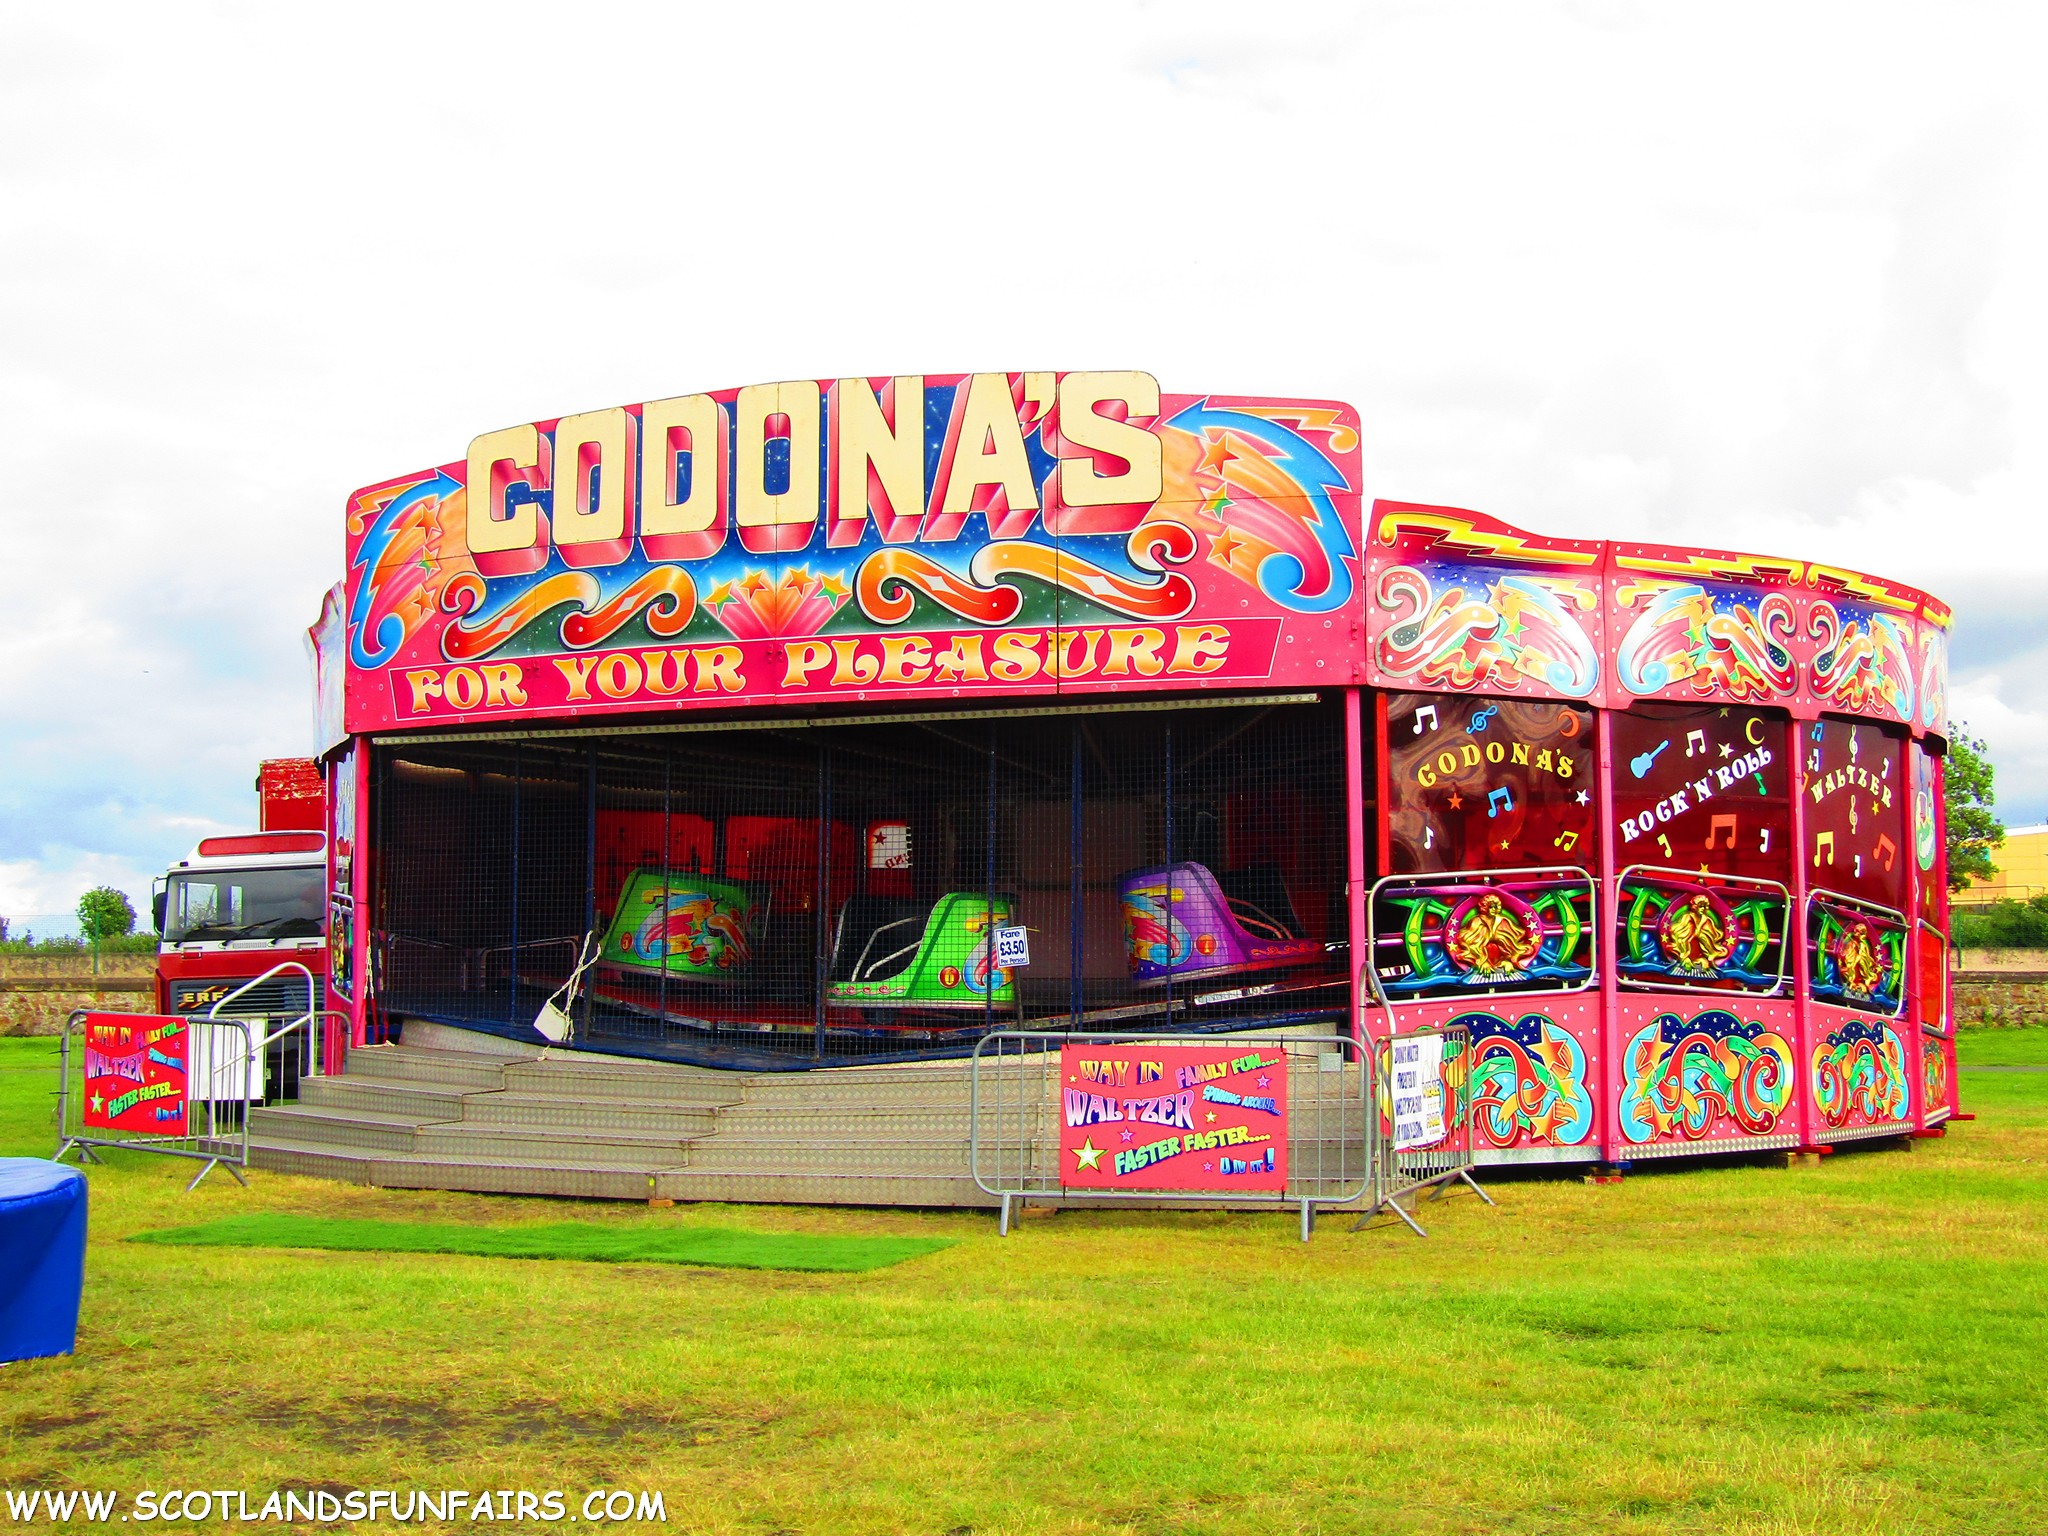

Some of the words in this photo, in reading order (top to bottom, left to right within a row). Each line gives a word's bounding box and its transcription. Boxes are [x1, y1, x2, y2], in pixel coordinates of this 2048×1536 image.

[466, 370, 1163, 558] CODONA'S
[405, 664, 528, 713] FOR
[552, 645, 747, 702] YOUR
[780, 625, 1231, 688] PLEASURE
[1417, 742, 1574, 788] CODONA'S
[1810, 764, 1892, 808] WALTZER
[1000, 930, 1020, 938] Fare
[1000, 939, 1025, 956] £3.50
[182, 991, 224, 1003] ERF
[119, 1027, 131, 1045] IN
[87, 1047, 145, 1084] WALTZER
[1079, 1060, 1130, 1086] WAY
[1138, 1061, 1164, 1084] IN
[1175, 1062, 1228, 1089] FAMILY
[1063, 1087, 1194, 1130] WALTZER
[1114, 1136, 1182, 1175] FASTER
